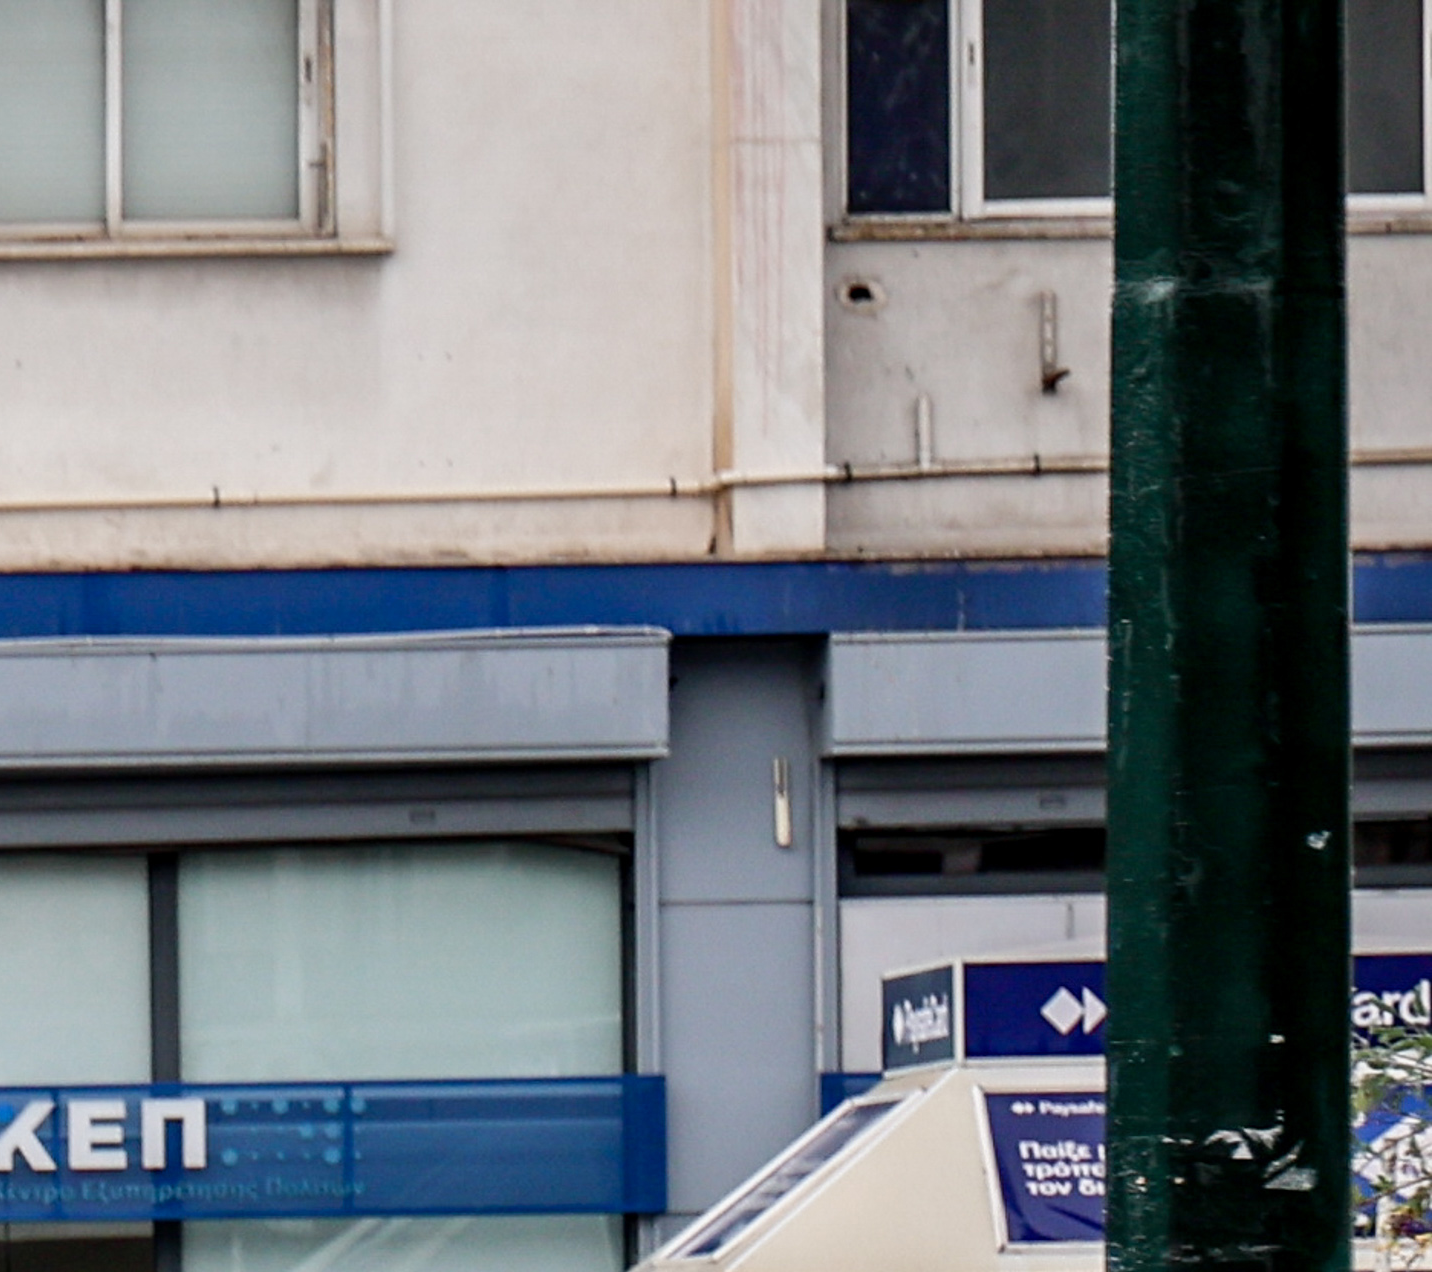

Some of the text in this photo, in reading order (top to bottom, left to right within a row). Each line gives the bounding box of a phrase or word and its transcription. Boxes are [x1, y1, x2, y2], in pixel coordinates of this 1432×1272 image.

[1018, 1140, 1091, 1162] Παίξε
[1022, 1162, 1106, 1181] τρόπο
[1026, 1181, 1072, 1196] τον
